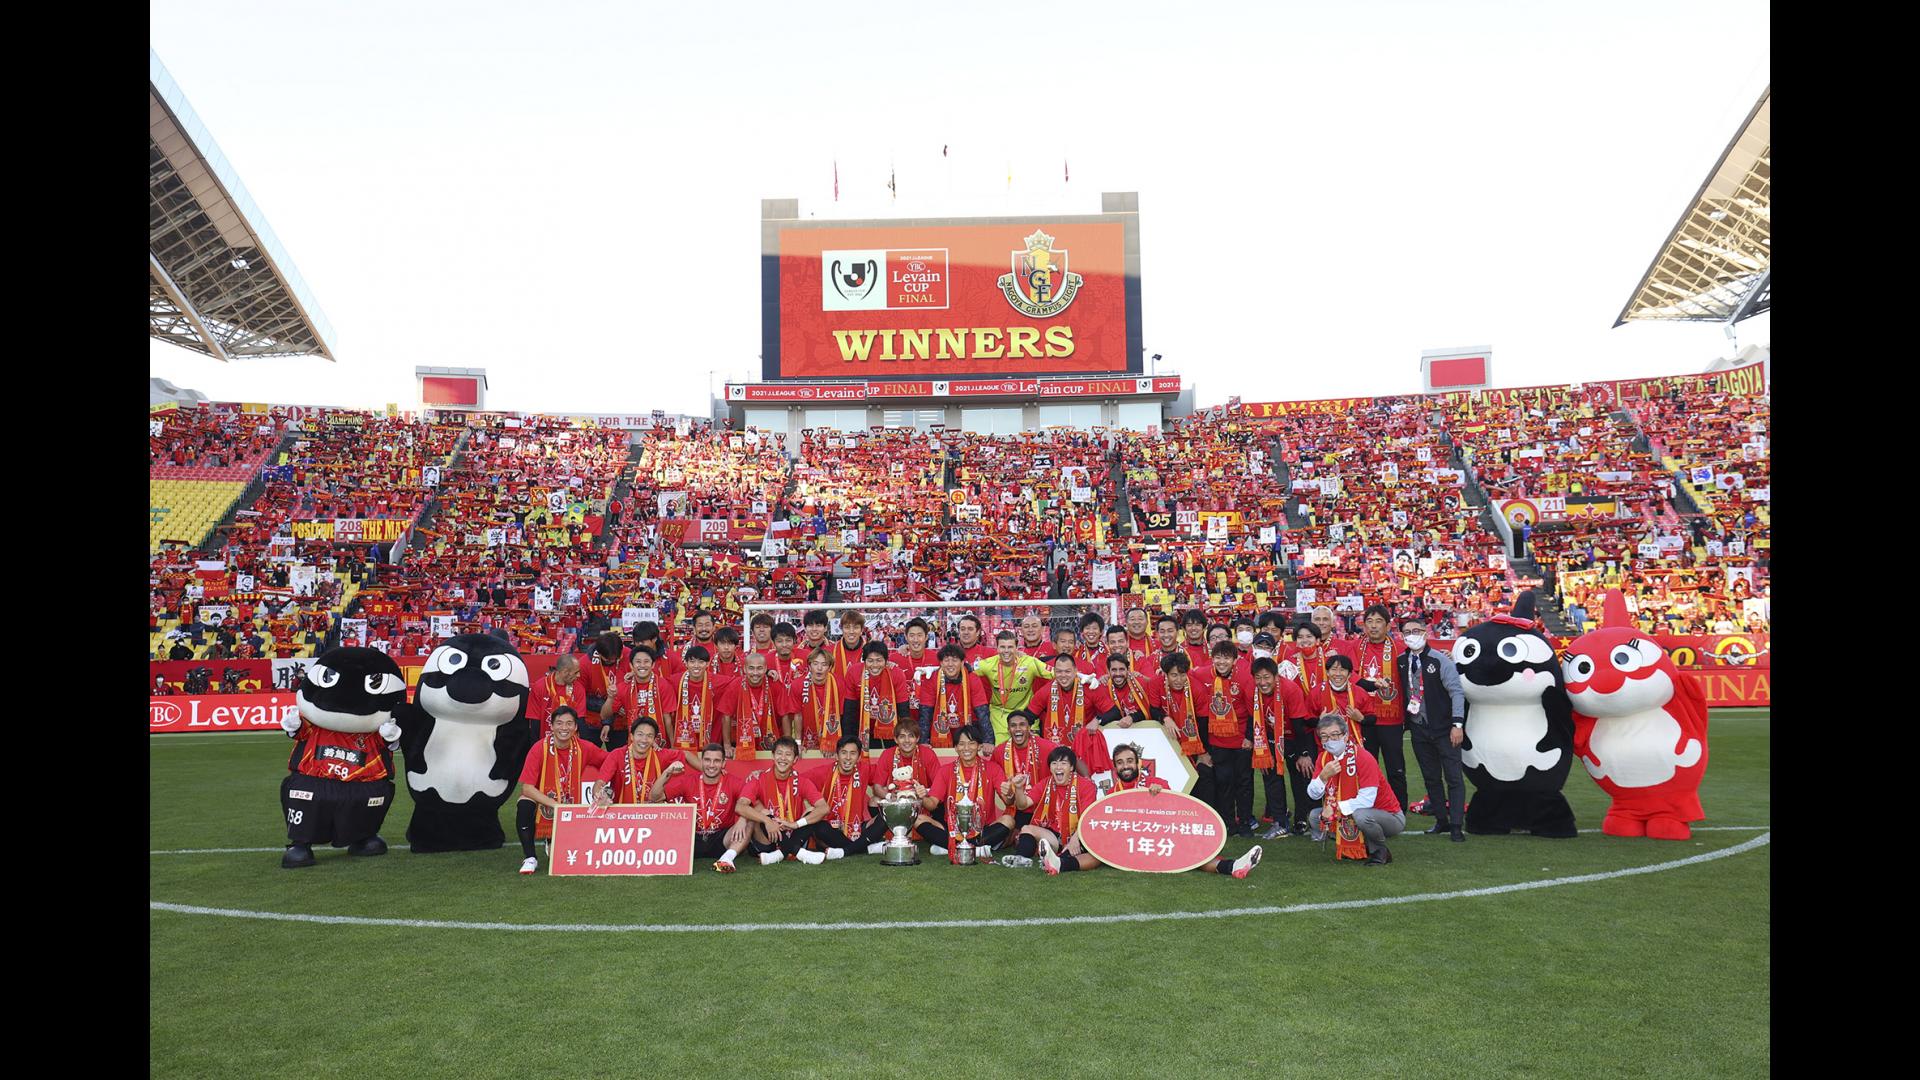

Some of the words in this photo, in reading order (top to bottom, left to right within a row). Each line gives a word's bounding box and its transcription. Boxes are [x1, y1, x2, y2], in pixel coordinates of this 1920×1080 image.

[893, 269, 941, 283] Levain
[903, 282, 930, 293] CUP
[898, 294, 936, 304] FINAL
[1005, 281, 1023, 308] NAGOYA
[1026, 302, 1062, 314] GRAMPUS
[1062, 280, 1075, 302] EIGHT
[832, 325, 1076, 362] WINNERS
[815, 387, 856, 399] Levain
[884, 383, 927, 395] FINAL
[1063, 385, 1084, 394] CUP
[1087, 381, 1131, 393] FINAL
[598, 416, 620, 426] FOR
[625, 416, 648, 426] THE
[1544, 500, 1565, 511] 211
[340, 520, 362, 532] 208
[705, 521, 726, 531] 209
[1146, 512, 1172, 528] '95
[1177, 512, 1196, 525] 210
[361, 519, 383, 540] THE
[200, 610, 210, 622] 3
[1693, 673, 1770, 702] INA
[150, 706, 175, 722] BC
[327, 762, 349, 779] 758
[288, 807, 303, 825] 758
[617, 812, 643, 820] Levain
[660, 812, 688, 820] FINAL
[1177, 809, 1199, 817] FINAL
[1089, 819, 1216, 836] ヤマザキビスケット社製品
[594, 828, 652, 844] MVP
[1126, 837, 1175, 857] 1年分
[566, 849, 578, 866] ¥
[584, 849, 678, 869] 1,000,000
